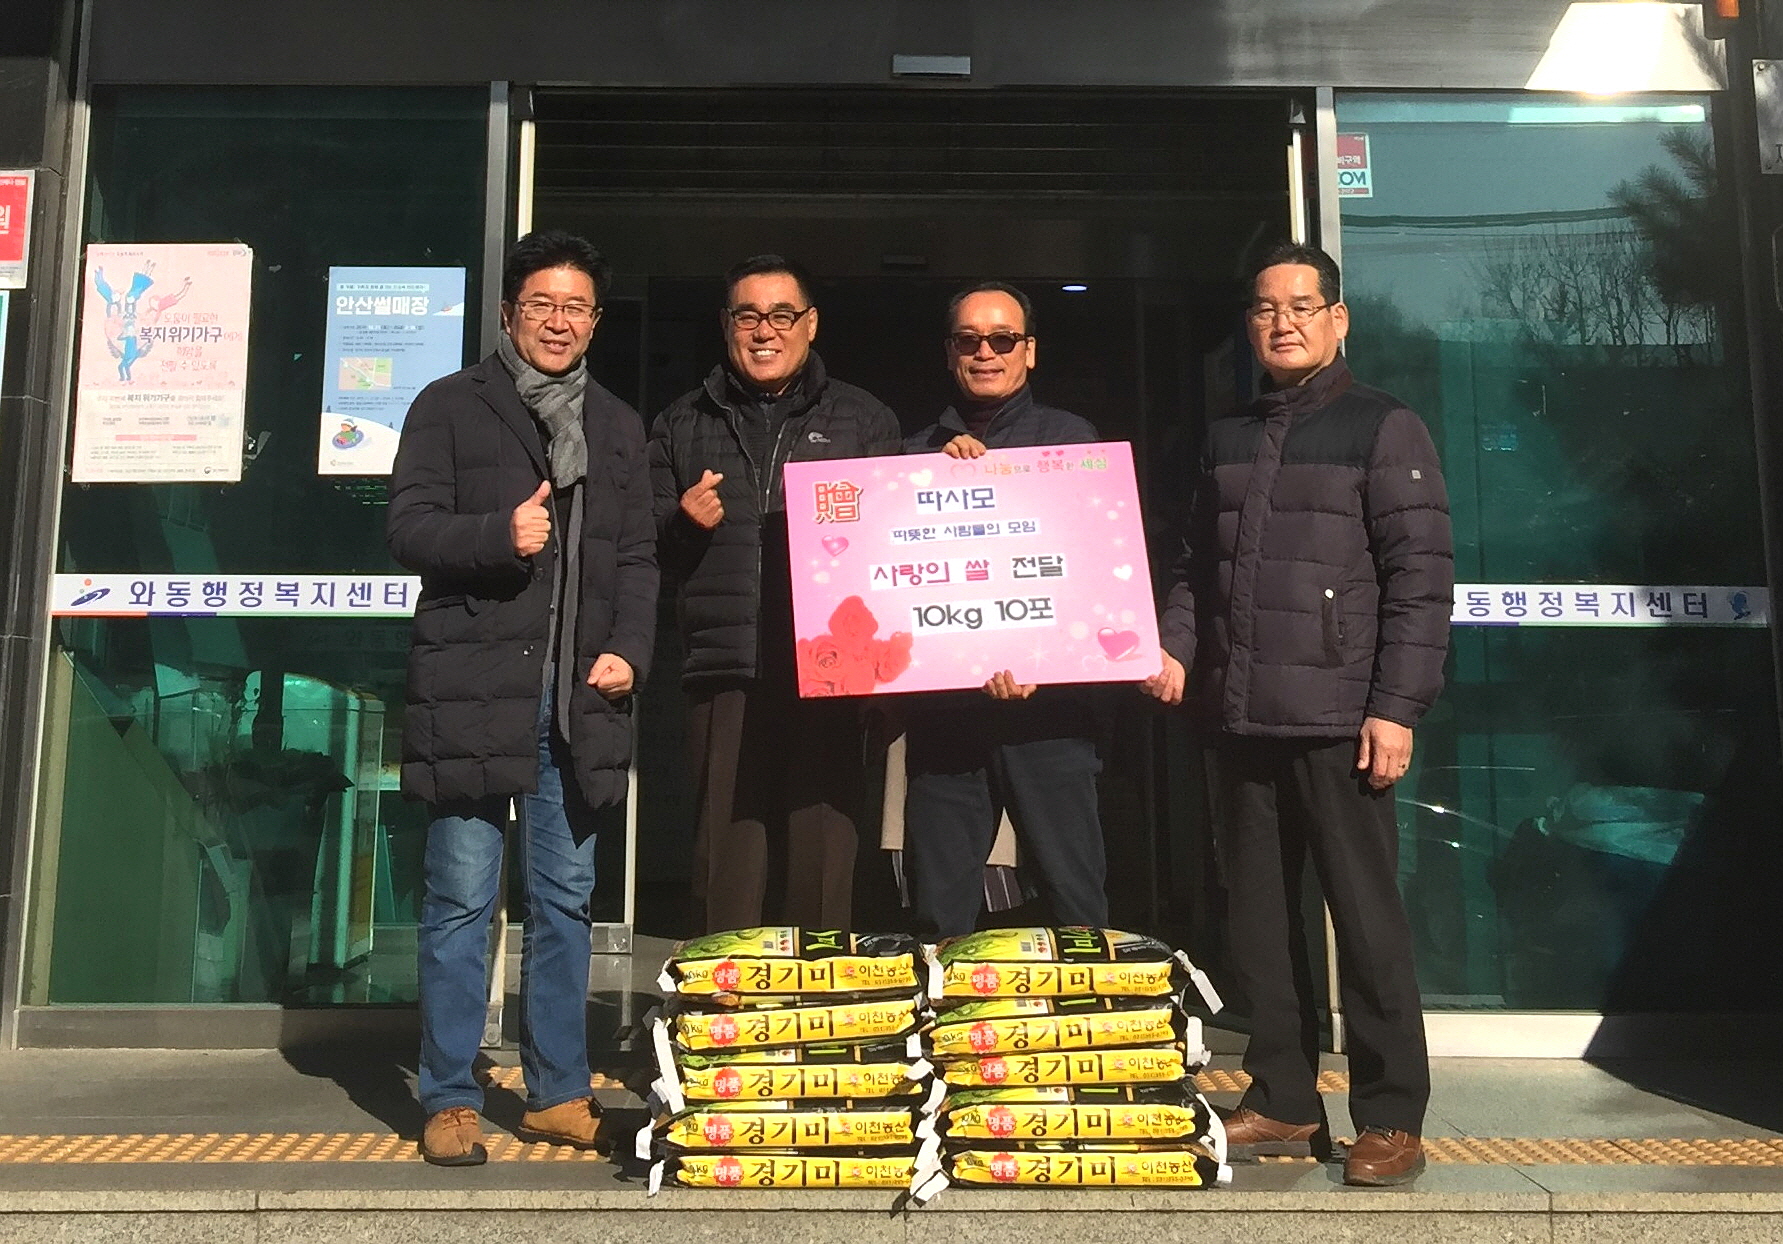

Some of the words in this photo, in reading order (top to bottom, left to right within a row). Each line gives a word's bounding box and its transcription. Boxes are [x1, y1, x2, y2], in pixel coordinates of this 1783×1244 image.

[1338, 171, 1366, 185] OM
[336, 295, 430, 316] 안산썰매장
[814, 481, 861, 523] 贈
[917, 487, 995, 511] 따사모
[893, 527, 936, 541] 따뜻한
[944, 523, 1000, 538] 사람들의
[1008, 520, 1036, 534] 모임
[874, 562, 950, 586] 사랑의
[965, 559, 990, 581] 쌀
[1012, 556, 1064, 578] 전달
[129, 580, 408, 608] 와동행정복지센터
[1464, 591, 1708, 618] 동행정복지센터
[913, 604, 983, 630] 10kg
[994, 597, 1054, 621] 10포
[746, 961, 834, 990] 경기미
[859, 963, 910, 978] 이천농산
[1006, 966, 1094, 993] 경기미
[746, 1010, 834, 1042] 경기미
[1004, 1017, 1092, 1048] 경기미
[1117, 1020, 1167, 1033] 이천농산
[748, 1068, 838, 1097] 경기미
[863, 1073, 906, 1085] 이천농
[1015, 1054, 1103, 1083] 경기미
[739, 1116, 829, 1145] 경기미
[855, 1121, 907, 1135] 이천농산
[1023, 1108, 1111, 1136] 경기미
[749, 1159, 839, 1186] 경기미
[866, 1165, 911, 1178] 이천농
[1026, 1156, 1115, 1183] 경기미
[1141, 1161, 1192, 1174] 이천농산
